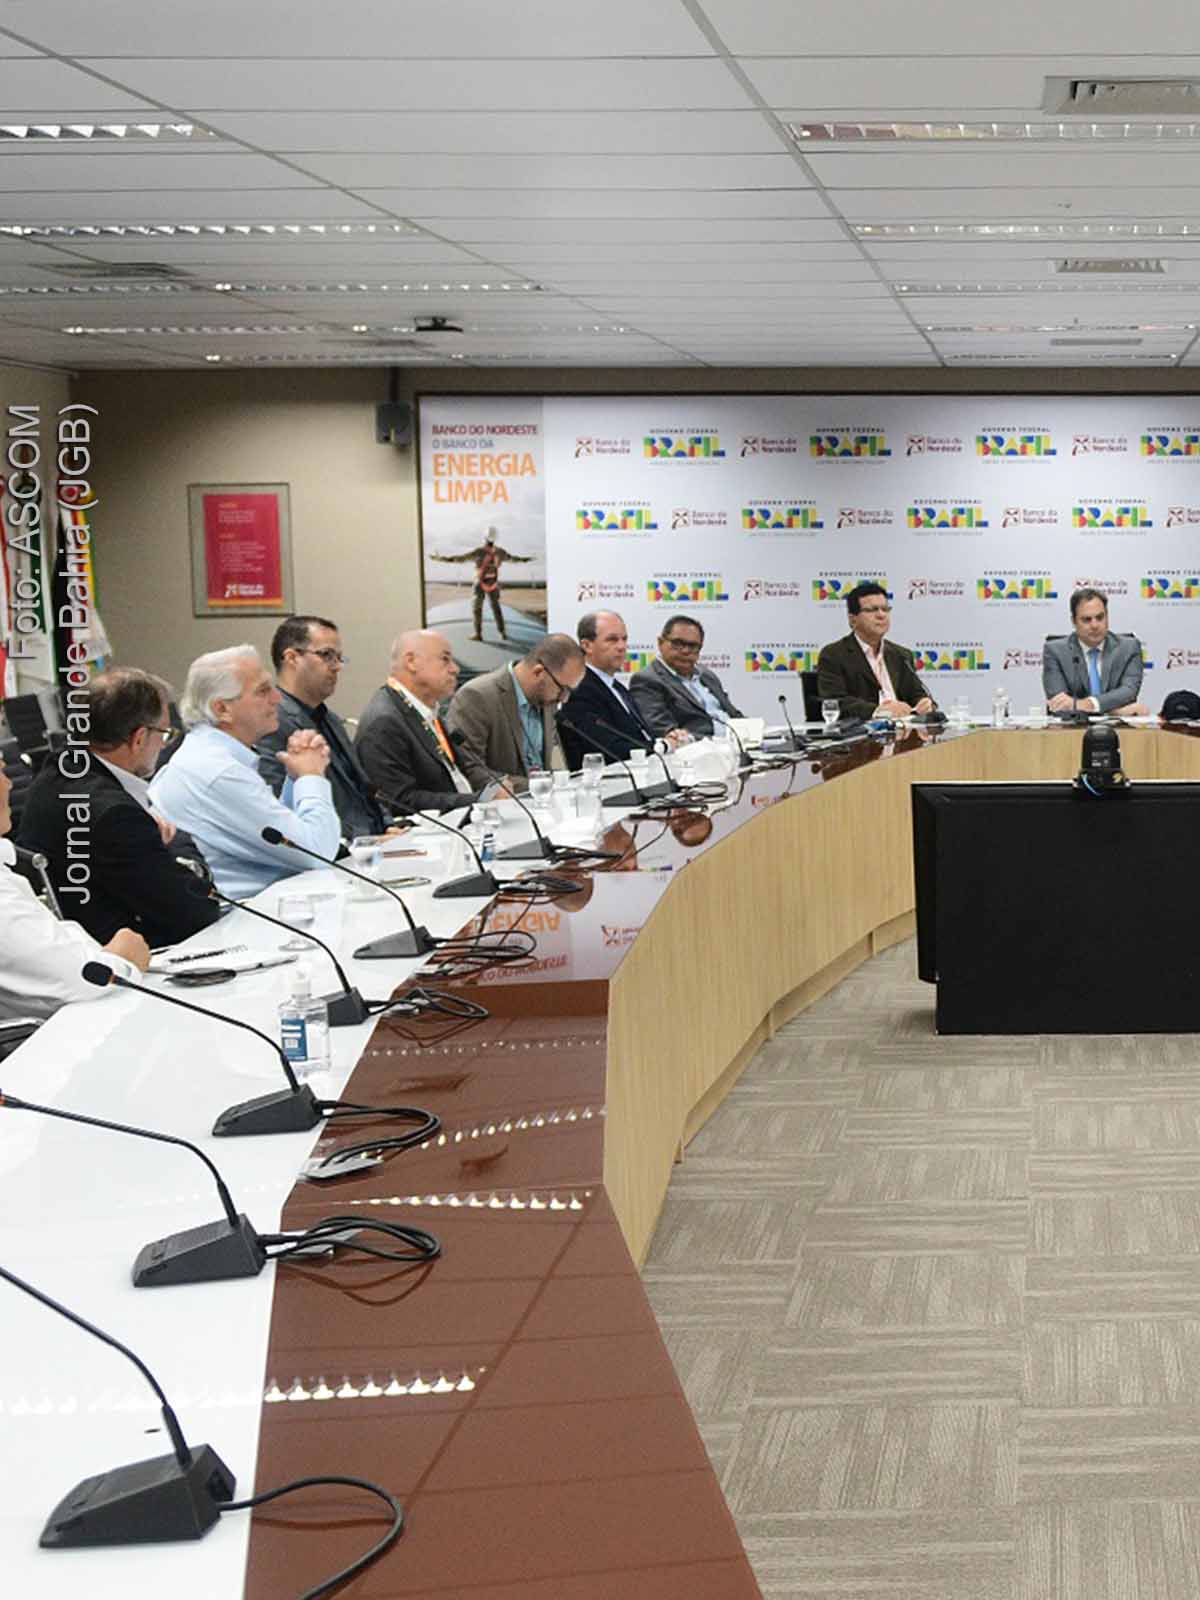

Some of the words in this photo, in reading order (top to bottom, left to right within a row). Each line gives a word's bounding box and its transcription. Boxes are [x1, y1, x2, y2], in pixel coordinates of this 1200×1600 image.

[431, 424, 467, 435] BANCO
[468, 424, 484, 435] DO
[486, 424, 537, 435] NORDESTE
[431, 439, 440, 449] O
[441, 439, 477, 449] BANCO
[479, 439, 496, 449] DA
[644, 437, 725, 457] BRASIL
[810, 436, 891, 456] BRASIL
[976, 436, 1057, 456] BRASIL
[432, 453, 537, 477] ENERGIA
[433, 479, 511, 504] LIMPA
[577, 510, 658, 529] BRASIL
[742, 509, 823, 528] BRASIL
[908, 508, 988, 528] BRASIL
[1073, 508, 1152, 527] BRASIL
[647, 581, 729, 601] BRASIL
[977, 579, 1058, 599] BRASIL
